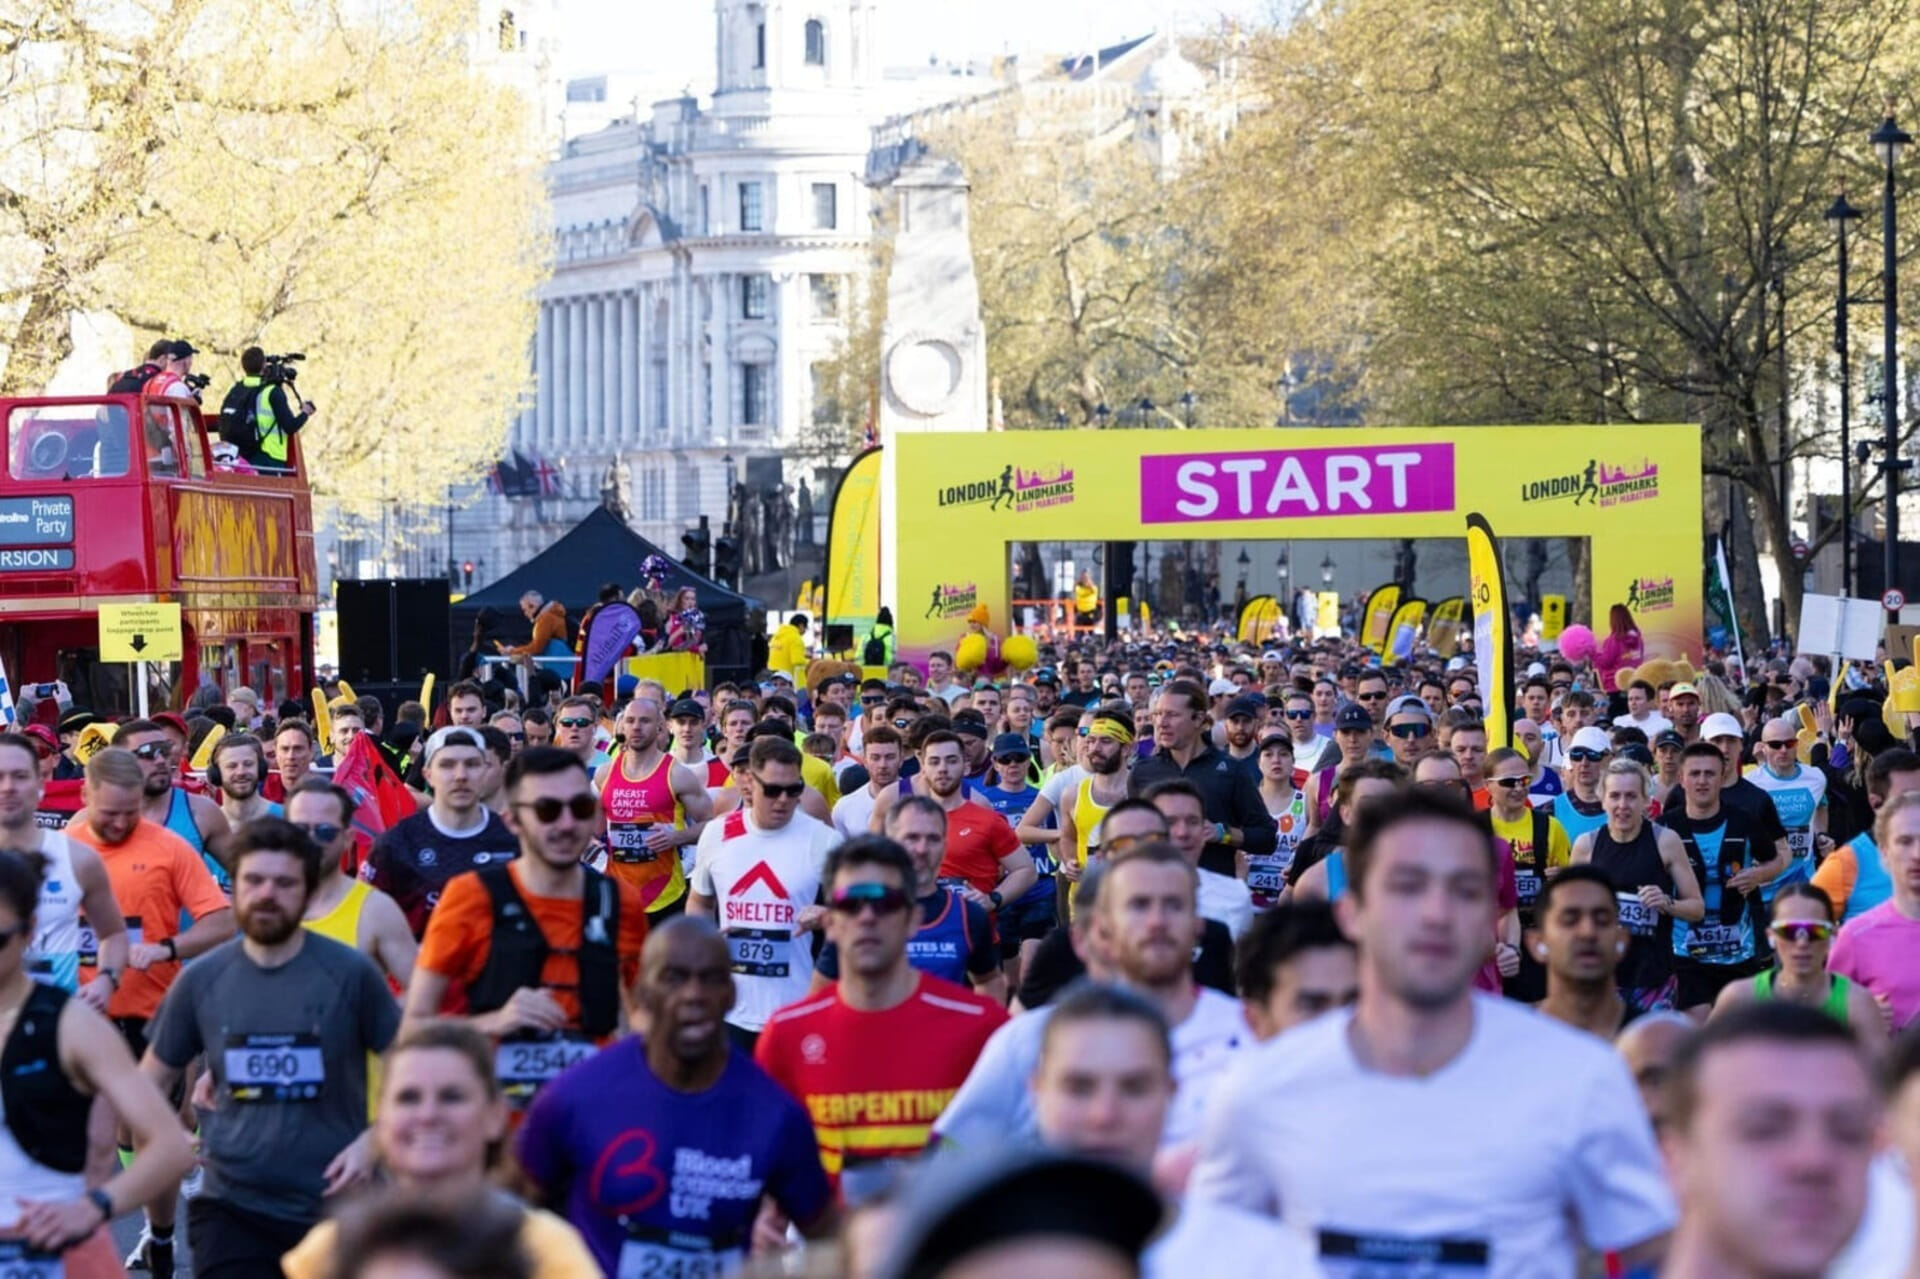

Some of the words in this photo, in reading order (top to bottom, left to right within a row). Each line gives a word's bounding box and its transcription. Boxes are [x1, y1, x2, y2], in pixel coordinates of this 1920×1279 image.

[938, 479, 997, 506] LONDON
[1015, 482, 1074, 503] LANDMARKS
[1175, 452, 1422, 518] START
[1522, 475, 1581, 502] LONDON
[1600, 476, 1658, 498] LANDMARKS
[32, 500, 71, 516] Private
[36, 517, 67, 538] Party
[0, 550, 58, 567] RSION
[1887, 594, 1902, 606] 20
[611, 799, 649, 809] CANCER
[613, 789, 648, 799] BREAST
[612, 808, 634, 818] NOW
[618, 833, 643, 846] 784
[726, 902, 794, 924] SHELTER
[739, 942, 774, 961] 879
[247, 1053, 299, 1078] 690
[806, 1088, 957, 1125] SERPENTIN
[675, 1147, 752, 1178] Blood
[669, 1193, 712, 1220] UK
